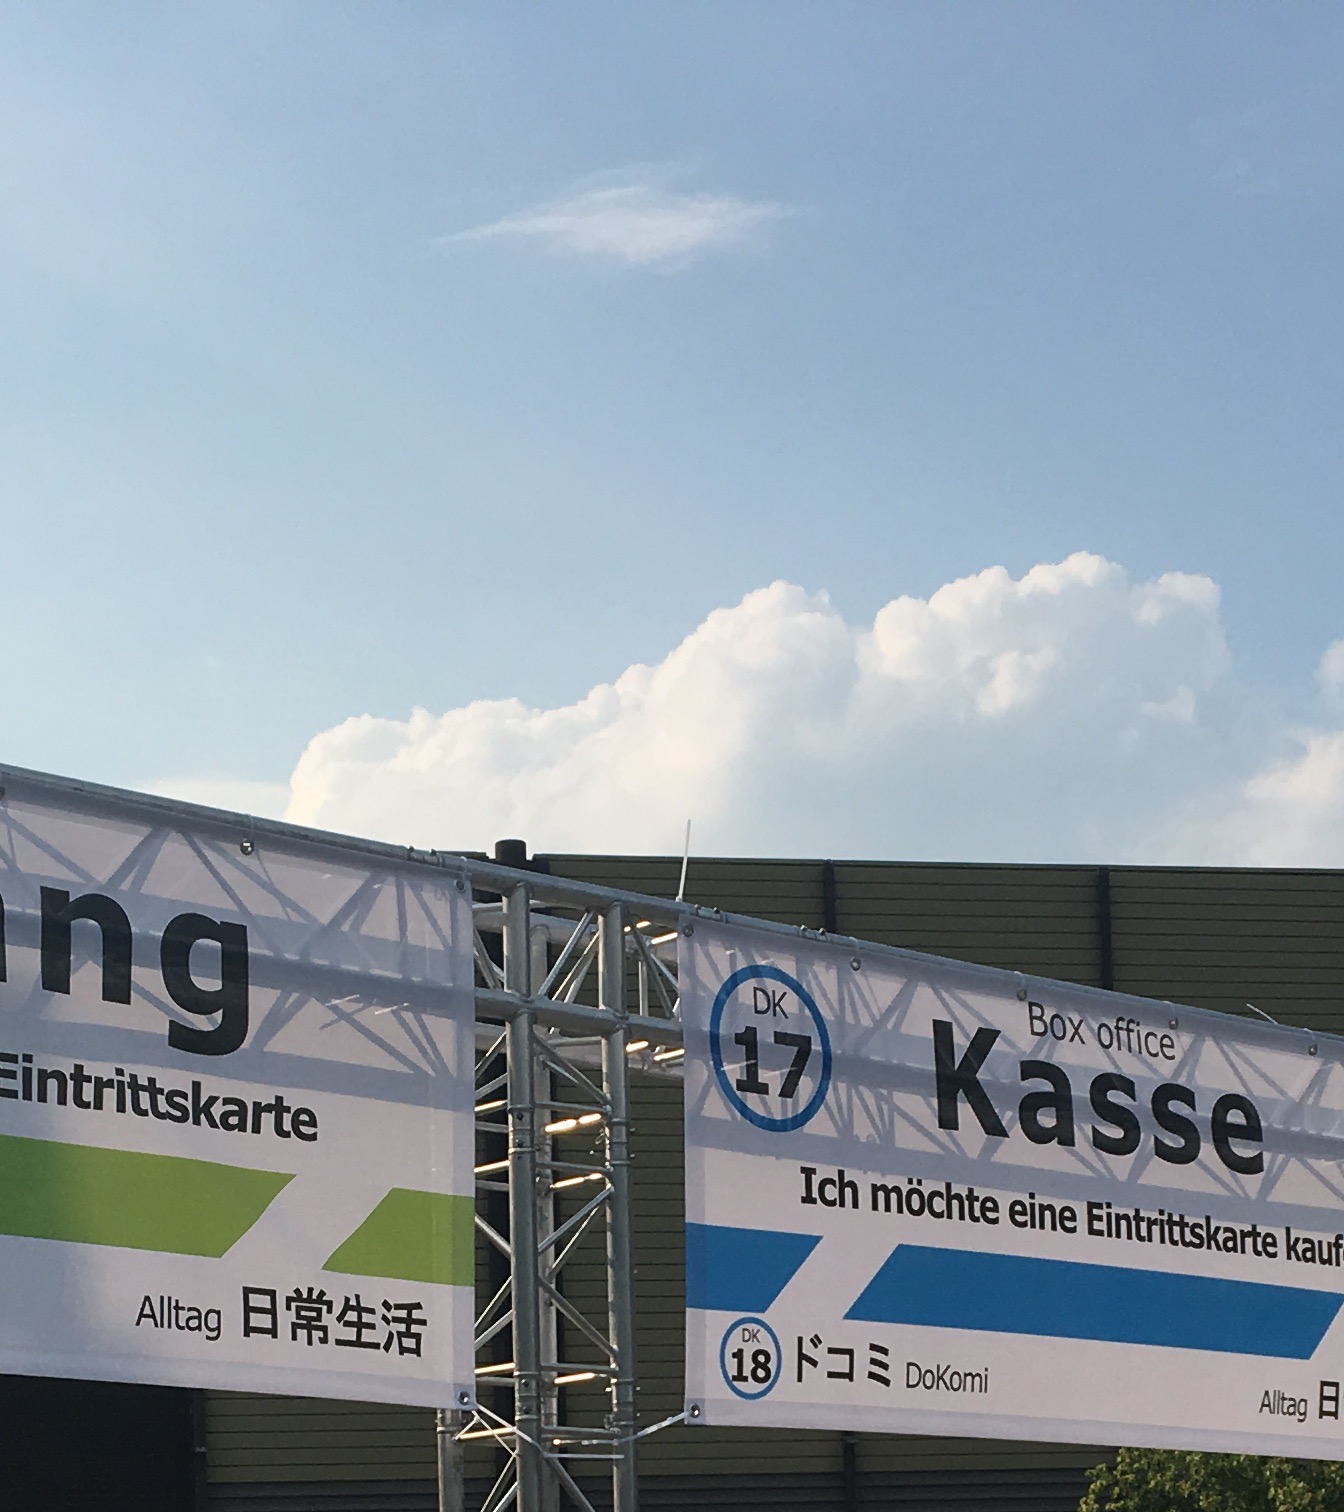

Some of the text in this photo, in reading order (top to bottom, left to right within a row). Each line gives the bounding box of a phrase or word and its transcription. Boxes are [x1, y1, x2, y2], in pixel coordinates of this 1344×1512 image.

[752, 986, 790, 1021] DK
[1027, 1001, 1177, 1062] Box office
[732, 1025, 813, 1100] 17
[931, 1018, 1266, 1176] Kasse
[799, 1165, 859, 1209] Ich
[869, 1176, 1001, 1226] möchte
[1008, 1190, 1078, 1236] eine
[1086, 1200, 1279, 1260] Eintrittskarte
[135, 1294, 223, 1343] Alltag
[241, 1284, 429, 1358] 日常生活
[740, 1327, 762, 1344] DK
[730, 1346, 773, 1385] 18
[795, 1333, 893, 1389] ドコミ
[905, 1361, 990, 1395] DoKomi
[1259, 1388, 1308, 1423] Alltag
